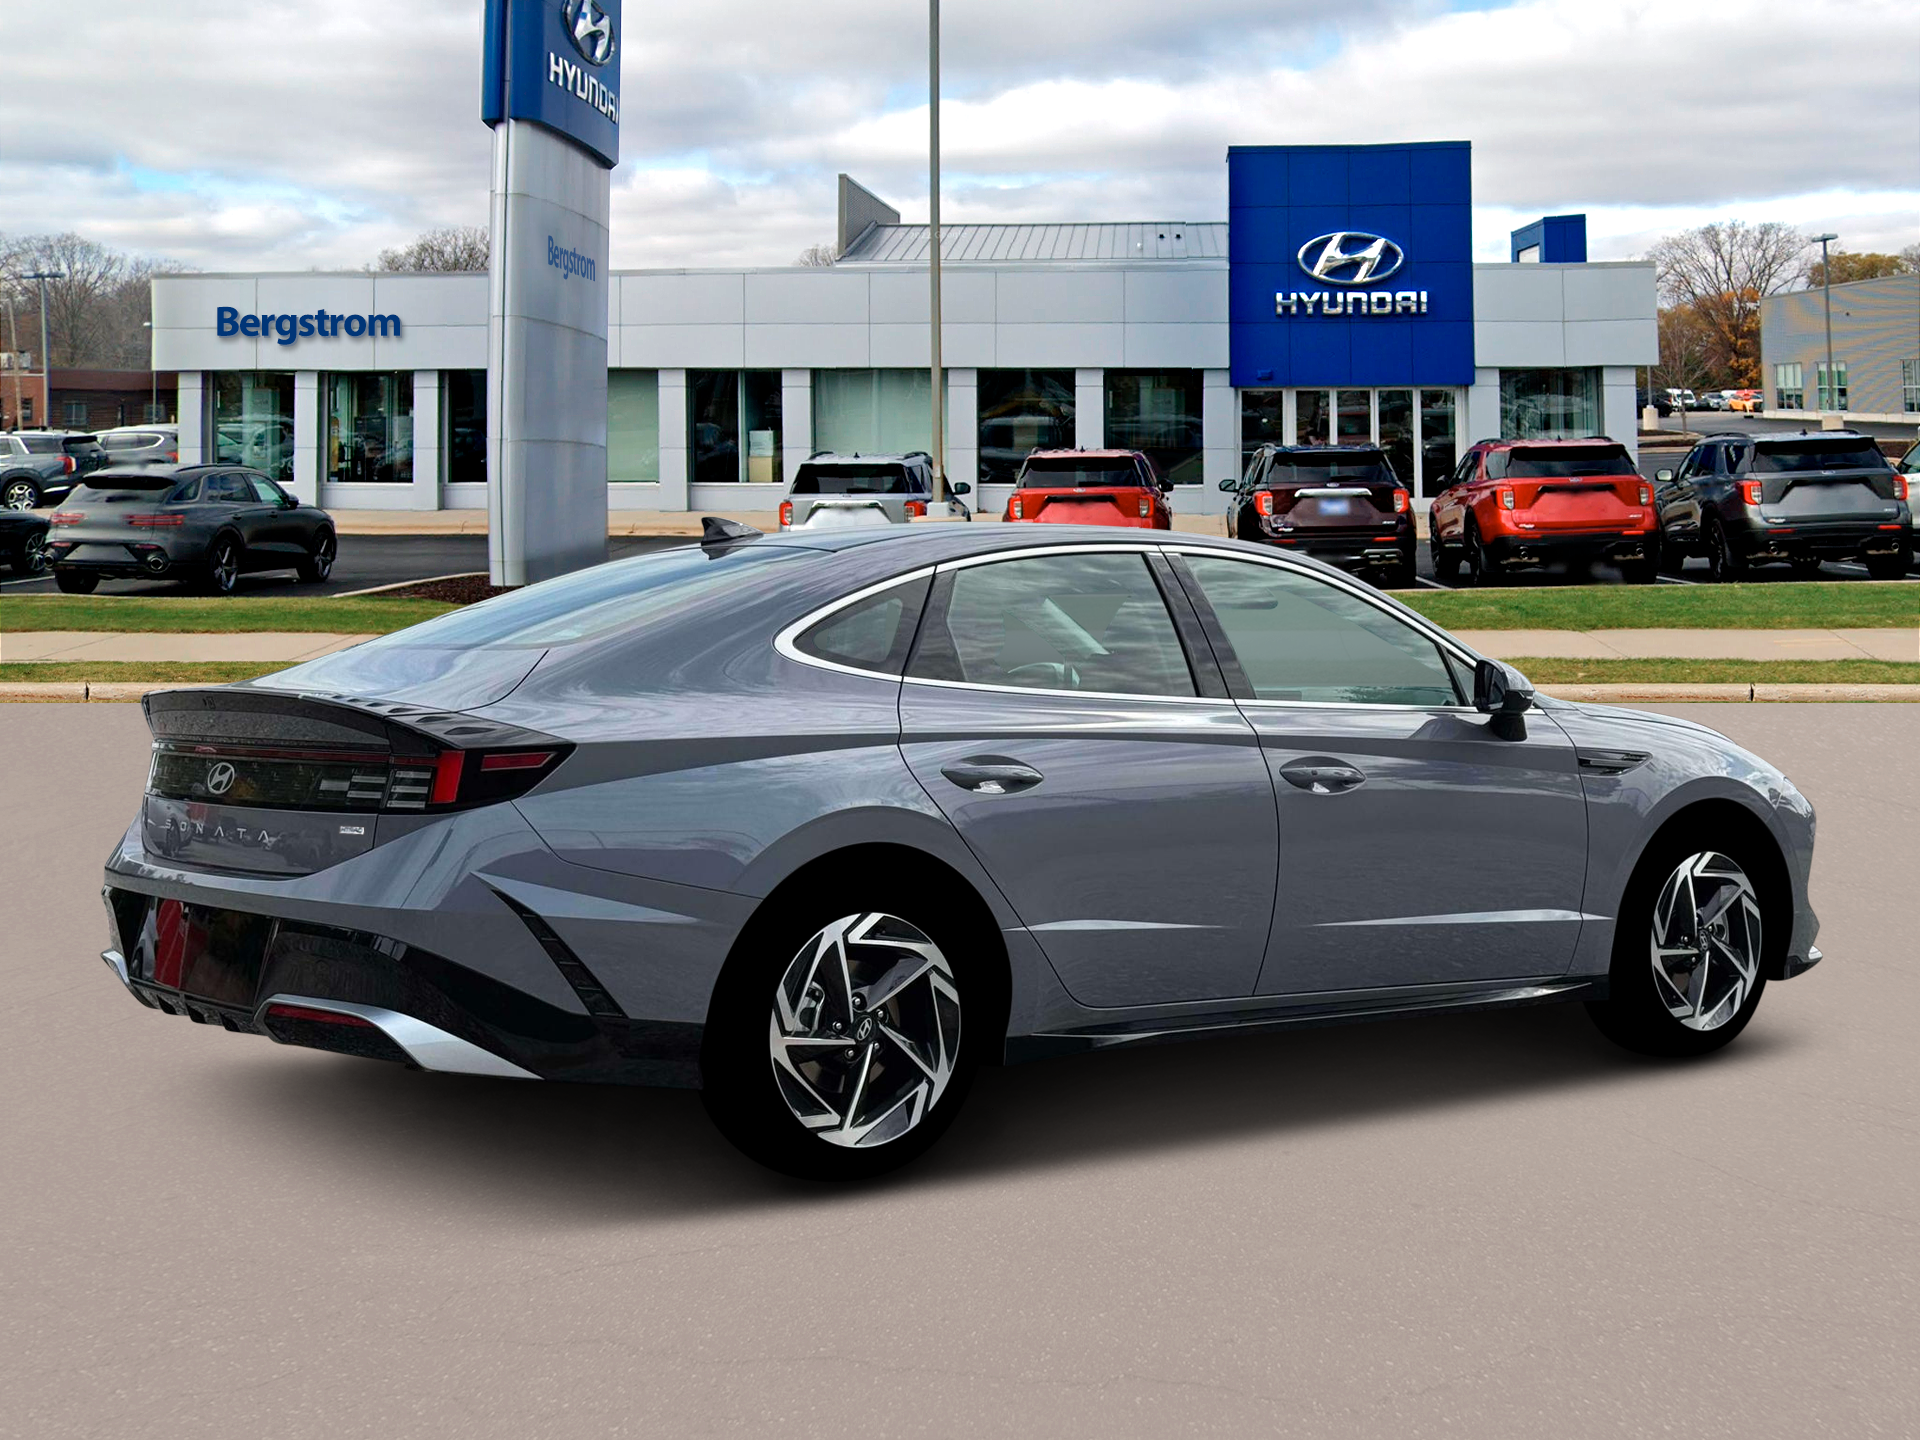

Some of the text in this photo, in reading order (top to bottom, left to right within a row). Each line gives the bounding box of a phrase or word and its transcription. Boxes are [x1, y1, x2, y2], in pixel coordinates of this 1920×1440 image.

[549, 52, 619, 124] HYUNDAI
[547, 235, 596, 282] Bergstrom
[1275, 290, 1428, 315] HYUNDAI
[216, 306, 402, 346] Bergstrom
[164, 818, 270, 843] SONATA
